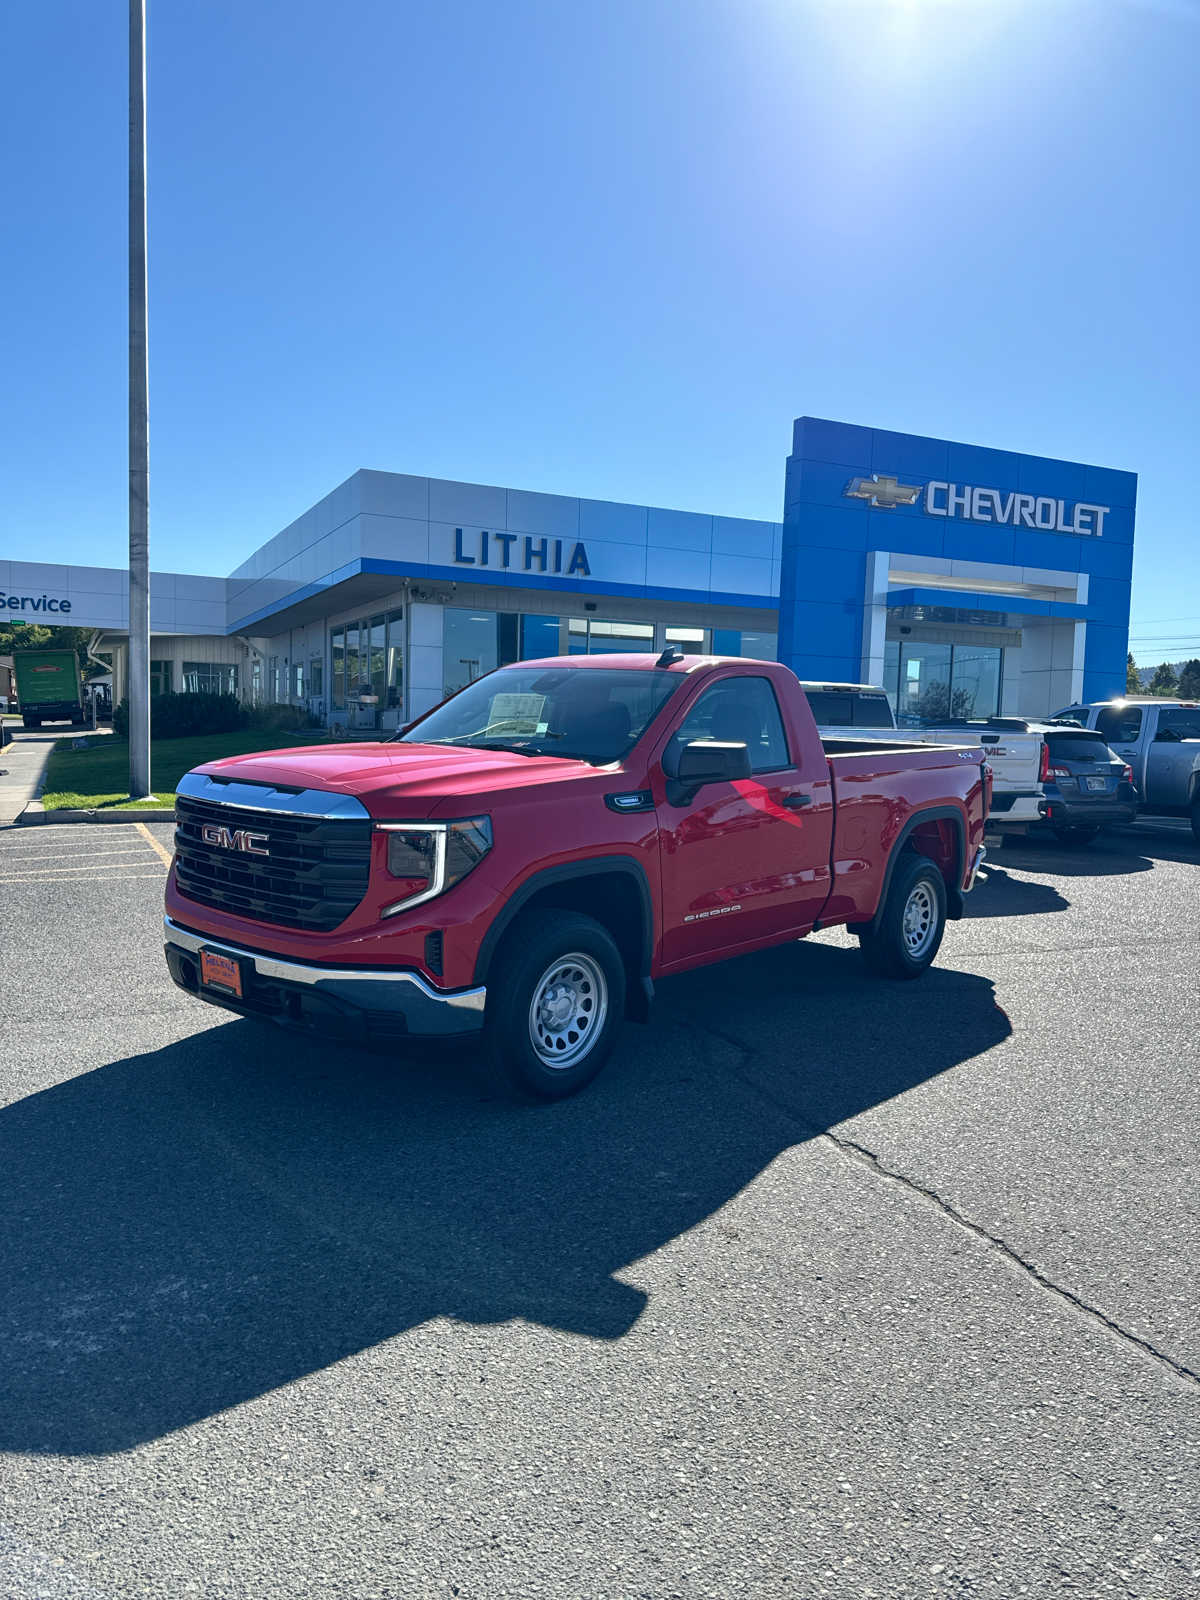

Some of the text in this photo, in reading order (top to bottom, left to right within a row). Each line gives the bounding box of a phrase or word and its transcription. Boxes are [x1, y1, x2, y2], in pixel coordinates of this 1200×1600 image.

[924, 480, 1111, 537] CHEVROLET
[455, 527, 591, 576] LITHIA
[201, 823, 270, 856] GMC
